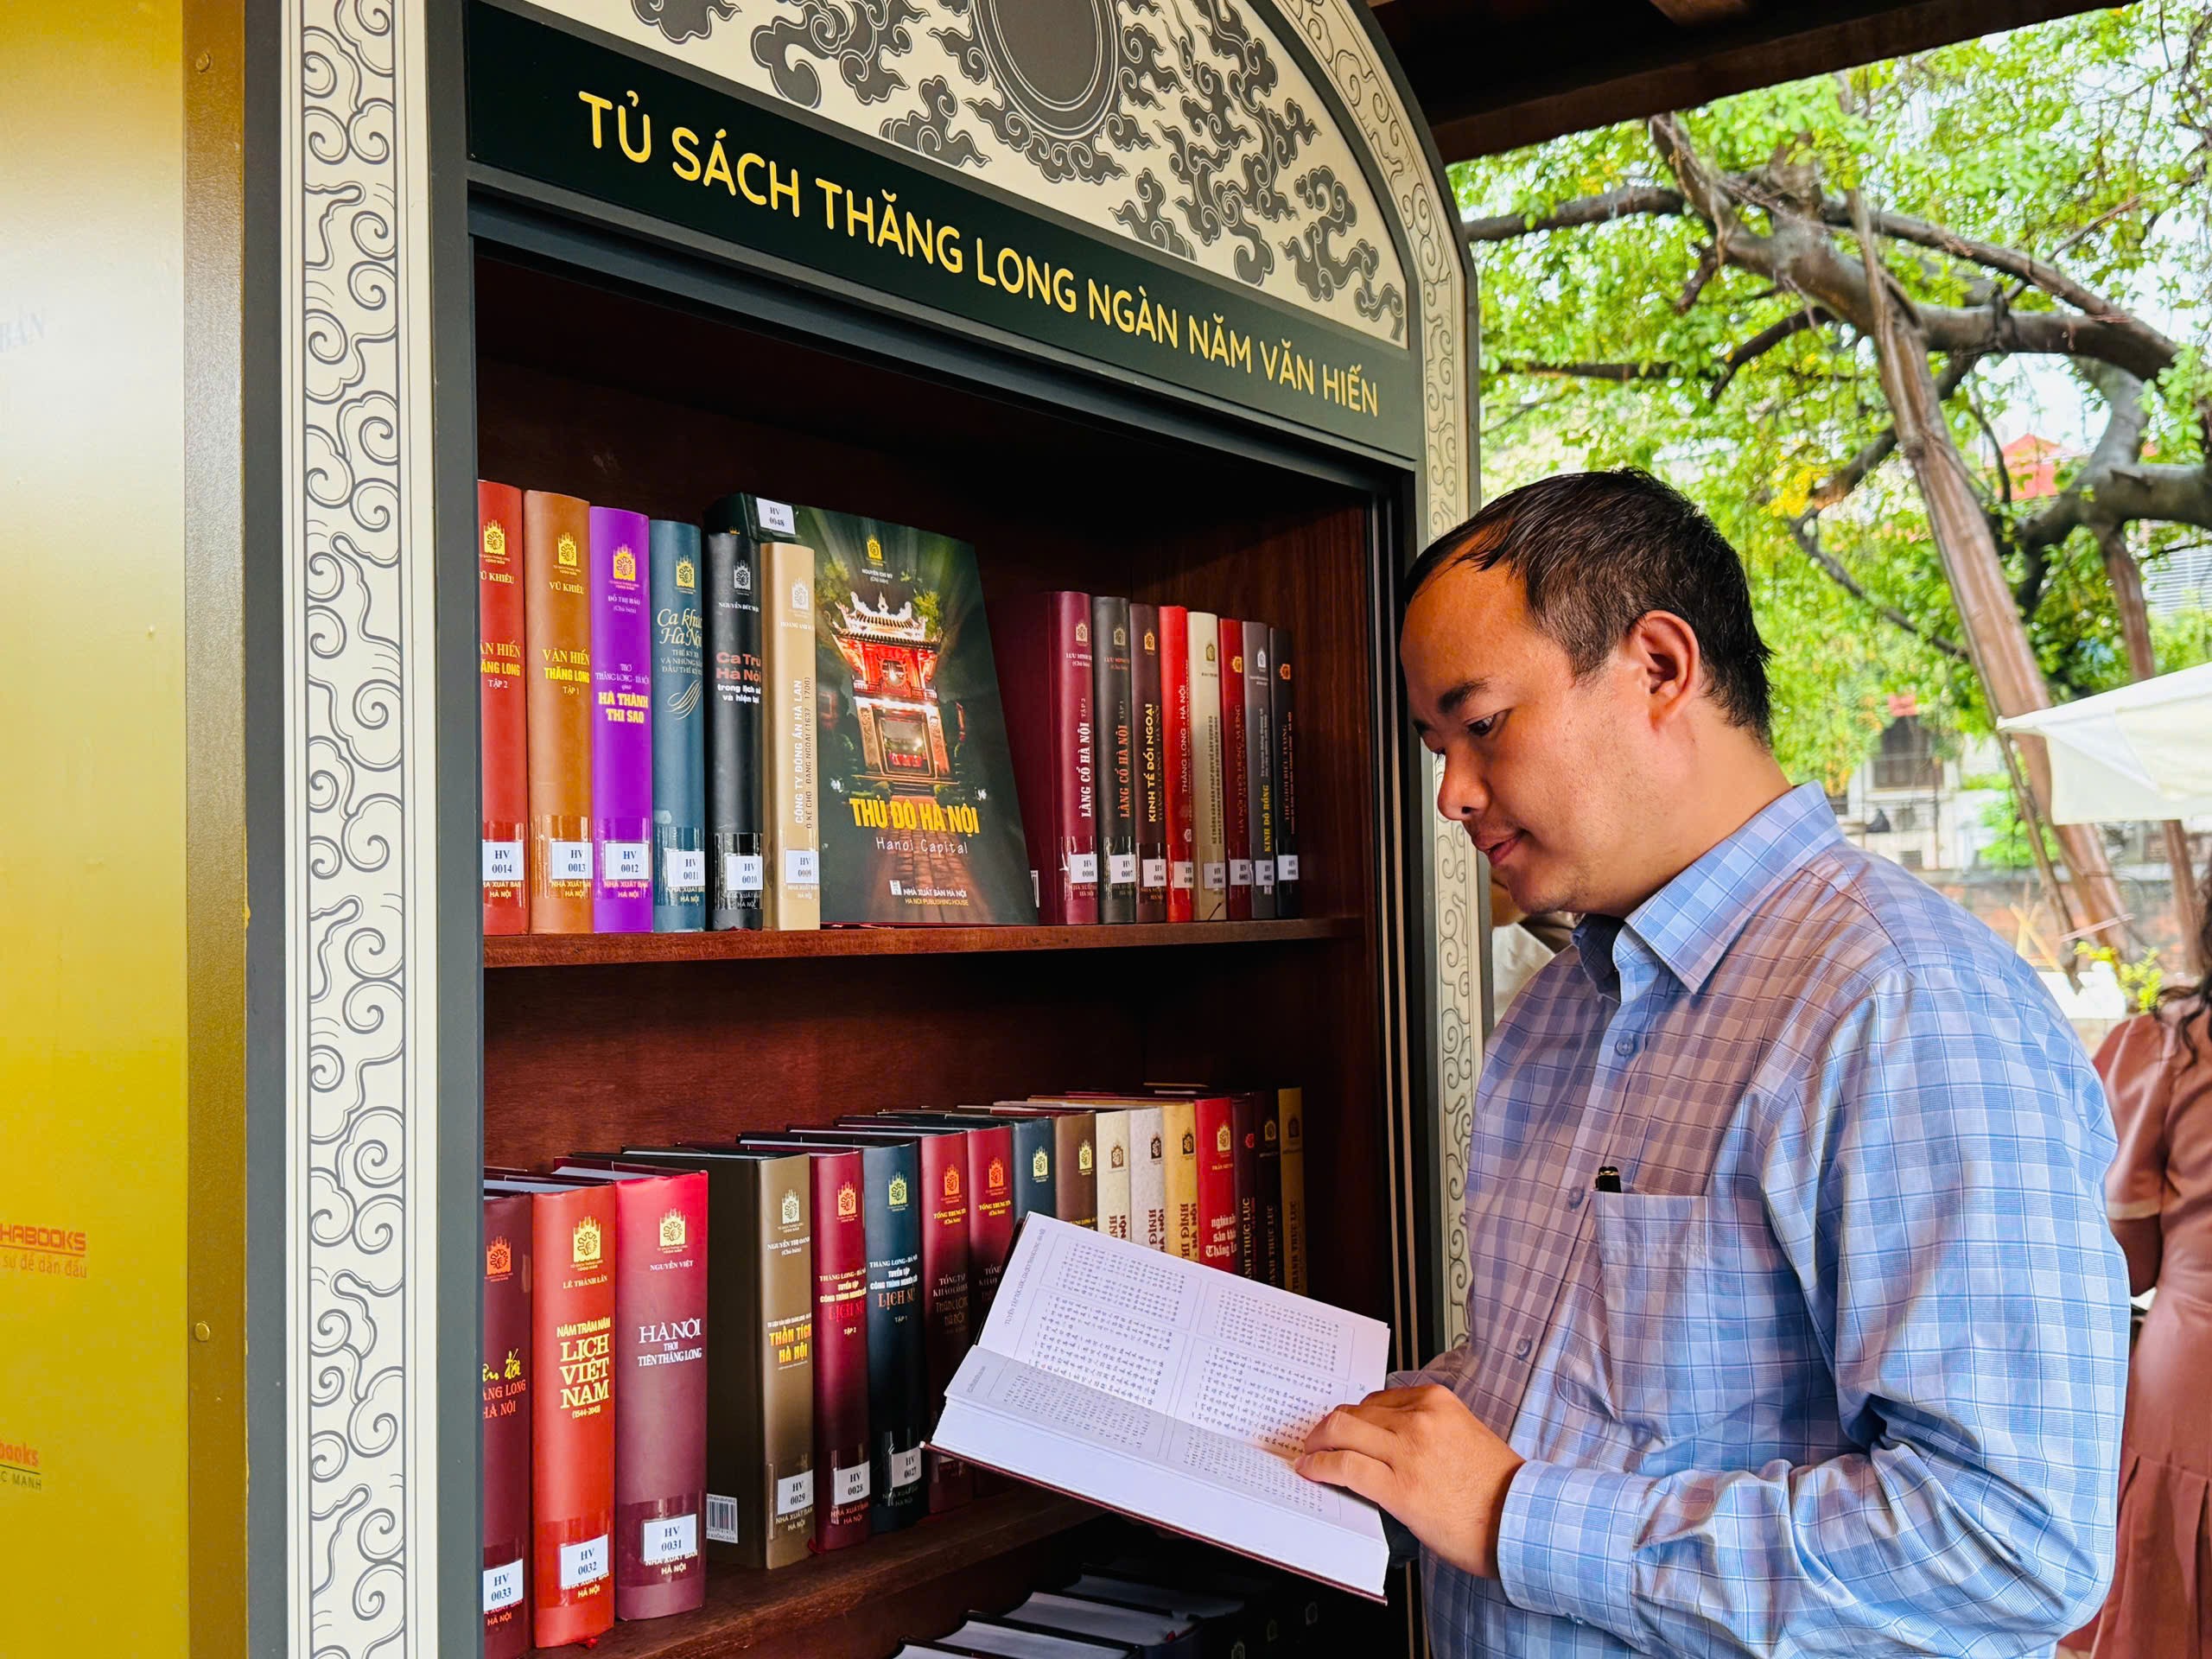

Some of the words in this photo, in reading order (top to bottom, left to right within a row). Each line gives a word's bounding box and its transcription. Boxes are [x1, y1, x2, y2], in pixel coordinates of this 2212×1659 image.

[579, 91, 652, 163] TỦ
[671, 128, 800, 218] SÁCH
[816, 178, 963, 273] THĂNG
[976, 238, 1077, 313] LONG
[1088, 278, 1178, 348] NGÀN
[1189, 313, 1251, 373] NĂM
[1260, 338, 1314, 395] VĂN
[1322, 364, 1378, 417] HIẾN
[770, 506, 779, 516] HV
[770, 518, 785, 527] 0048
[659, 626, 684, 644] Hà
[542, 648, 568, 662] VĂN
[716, 652, 741, 664] Ca
[543, 666, 573, 681] THĂNG
[575, 669, 589, 683] LONG
[716, 668, 741, 680] Hà
[487, 678, 502, 690] TẬP
[563, 685, 575, 695] TẬP
[617, 693, 649, 708] THÀNH
[736, 694, 751, 703] hiện
[606, 709, 625, 721] THI
[626, 711, 644, 723] SAO
[1179, 705, 1185, 719] HÀ
[1145, 703, 1155, 744] NGOẠI
[1077, 722, 1090, 743] NỘI
[1116, 725, 1128, 743] NỘI
[1077, 747, 1090, 764] HÀ
[1117, 748, 1128, 765] HÀ
[1142, 747, 1154, 770] ĐỐI
[1077, 766, 1090, 783] CỔ
[1115, 768, 1129, 783] CỔ
[1143, 773, 1155, 788] TẾ
[795, 776, 803, 790] TY
[794, 794, 804, 823] CÔNG
[1078, 787, 1092, 817] LÀNG
[1118, 787, 1130, 817] LÀNG
[1147, 791, 1156, 822] KINH
[849, 795, 888, 830] THỦ
[890, 799, 917, 830] ĐÔ
[918, 801, 947, 832] HÀ
[947, 803, 980, 837] NỘI
[1263, 812, 1270, 826] ĐÔ
[876, 836, 914, 851] Hanoi
[921, 839, 968, 856] Capital
[494, 850, 510, 859] HV
[570, 849, 583, 859] HV
[623, 850, 636, 859] HV
[569, 863, 586, 873] 0013
[621, 864, 639, 873] 0012
[685, 858, 696, 867] HV
[799, 857, 810, 866] HV
[492, 865, 512, 874] 0014
[683, 871, 699, 880] 0011
[742, 874, 758, 883] 0010
[501, 890, 512, 899] NỘI
[629, 890, 639, 899] NỘI
[1148, 1210, 1157, 1244] ĐÌNH
[1179, 1204, 1189, 1239] ĐÌNH
[650, 1261, 677, 1272] NGUYỄN
[556, 1324, 576, 1338] NĂM
[577, 1320, 597, 1335] TRĂM
[639, 1321, 669, 1344] HÀ
[671, 1318, 702, 1339] NỘI
[769, 1325, 794, 1346] THẦN
[560, 1333, 609, 1362] LỊCH
[664, 1341, 678, 1351] THỜI
[779, 1345, 791, 1363] HÀ
[794, 1342, 808, 1360] NỘI
[638, 1355, 658, 1367] TIỀN
[658, 1351, 684, 1364] THĂNG
[685, 1348, 702, 1359] LONG
[559, 1357, 609, 1385] VIỆT
[560, 1379, 609, 1409] NAM
[501, 1400, 516, 1415] NỘI
[906, 1455, 914, 1465] HV
[849, 1472, 861, 1483] HV
[904, 1466, 916, 1478] 0027
[792, 1481, 804, 1491] HV
[848, 1484, 863, 1496] 0028
[790, 1493, 805, 1504] 0029
[664, 1526, 680, 1538] HV
[661, 1539, 682, 1551] 0031
[581, 1548, 594, 1560] HV
[577, 1562, 597, 1575] 0032
[661, 1565, 672, 1575] HÀ
[674, 1562, 686, 1573] NỘI
[493, 1573, 510, 1586] HV
[492, 1588, 512, 1601] 0033
[577, 1589, 588, 1598] HÀ
[588, 1585, 601, 1593] NỘI
[487, 1616, 499, 1626] HÀ
[499, 1612, 512, 1623] NỘI
